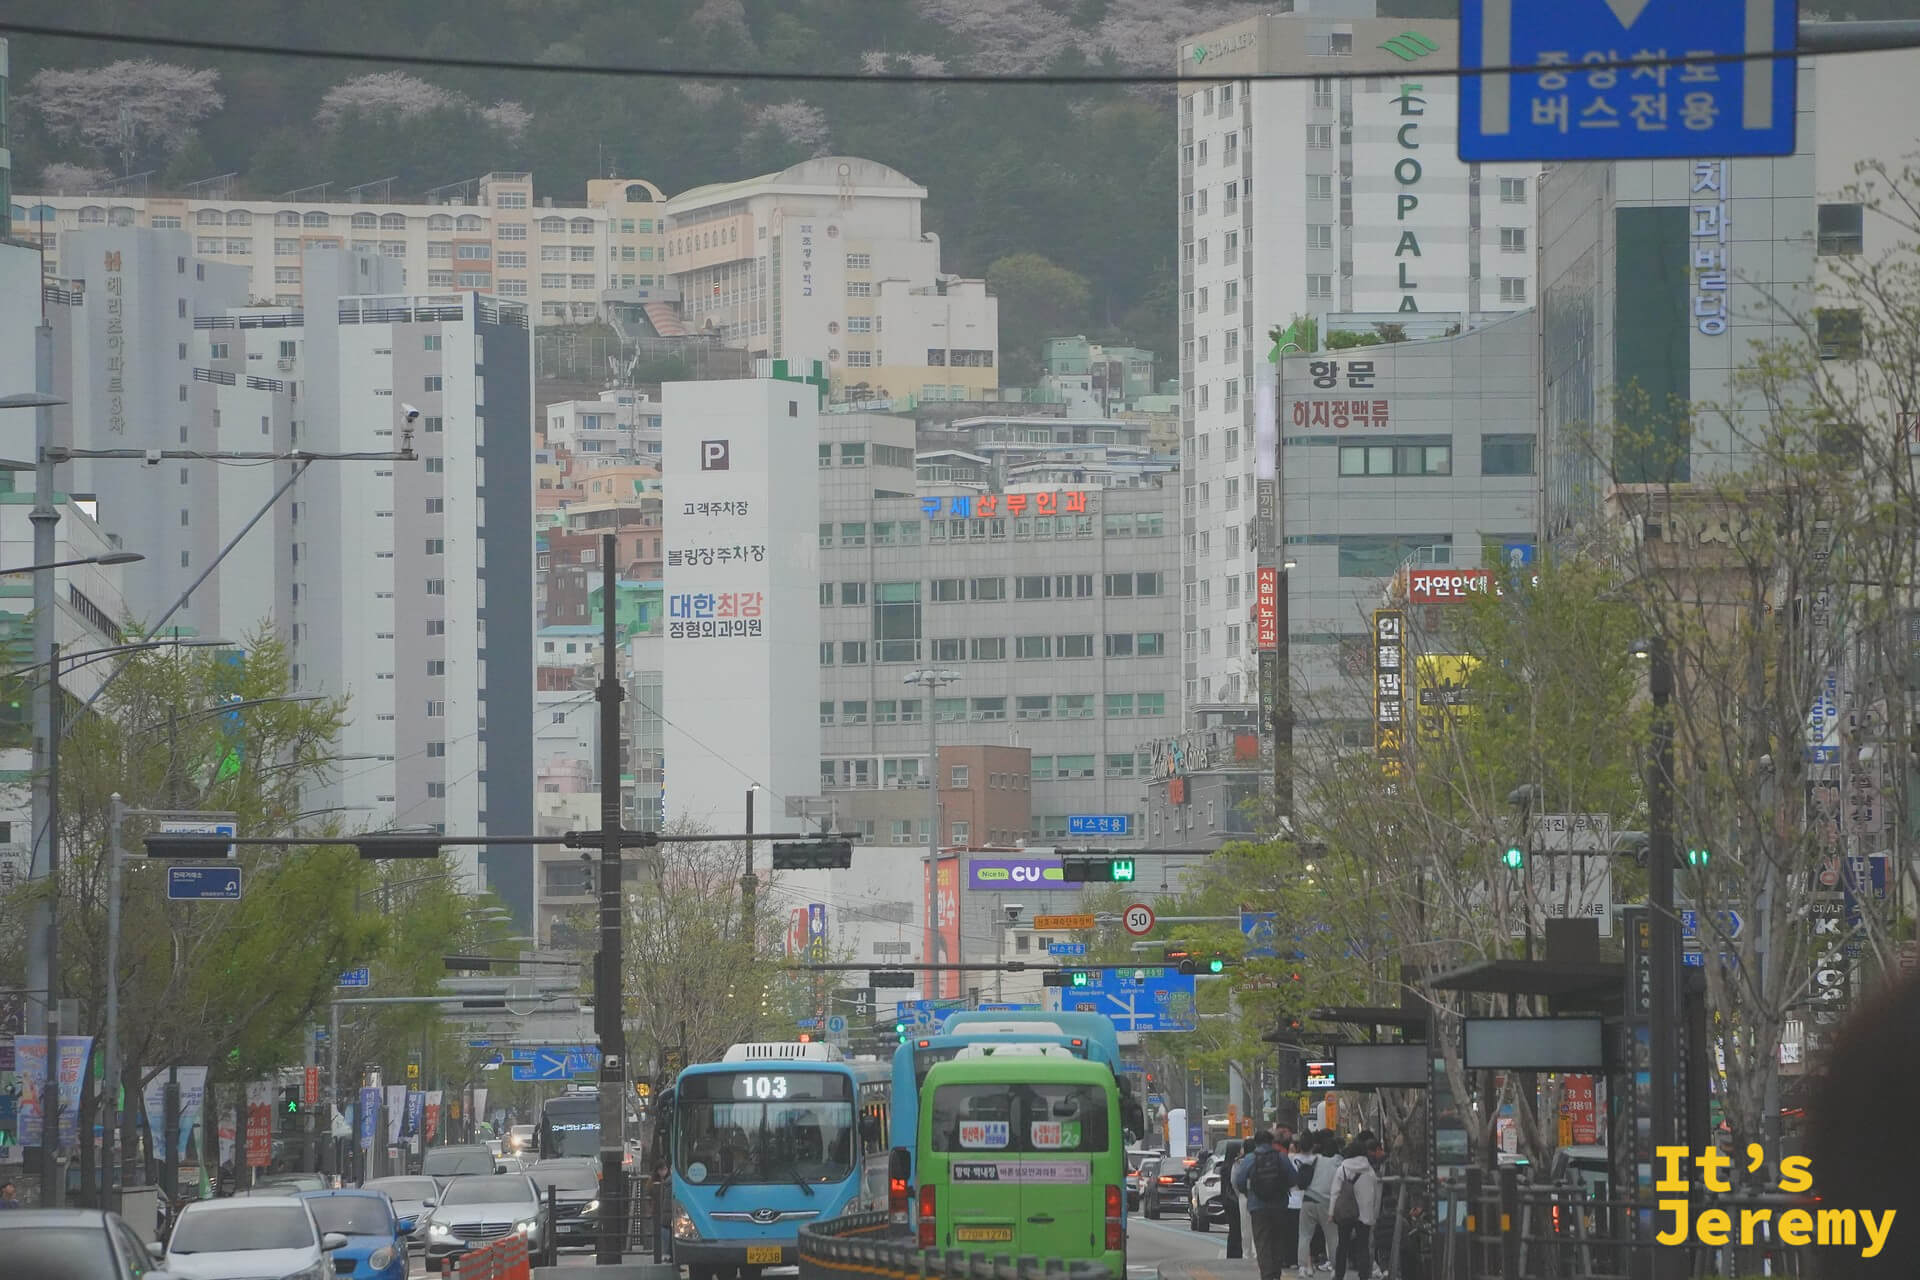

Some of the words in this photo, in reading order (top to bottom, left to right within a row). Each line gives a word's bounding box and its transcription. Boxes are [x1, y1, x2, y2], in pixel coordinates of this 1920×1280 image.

[1535, 50, 1720, 91] 중앙차로
[1532, 92, 1720, 134] 버스전용
[1692, 159, 1731, 336] 치과빌딩
[1309, 360, 1376, 389] 항문
[683, 500, 749, 517] 고객주차장
[920, 491, 1087, 520] 구세산부인과
[670, 592, 763, 618] 대한최강
[669, 619, 763, 639] 정형외과의원
[1073, 818, 1121, 831] 버스전용
[982, 870, 998, 878] Nice
[1012, 866, 1040, 881] CU
[1131, 914, 1147, 926] 50
[742, 1076, 787, 1099] 103
